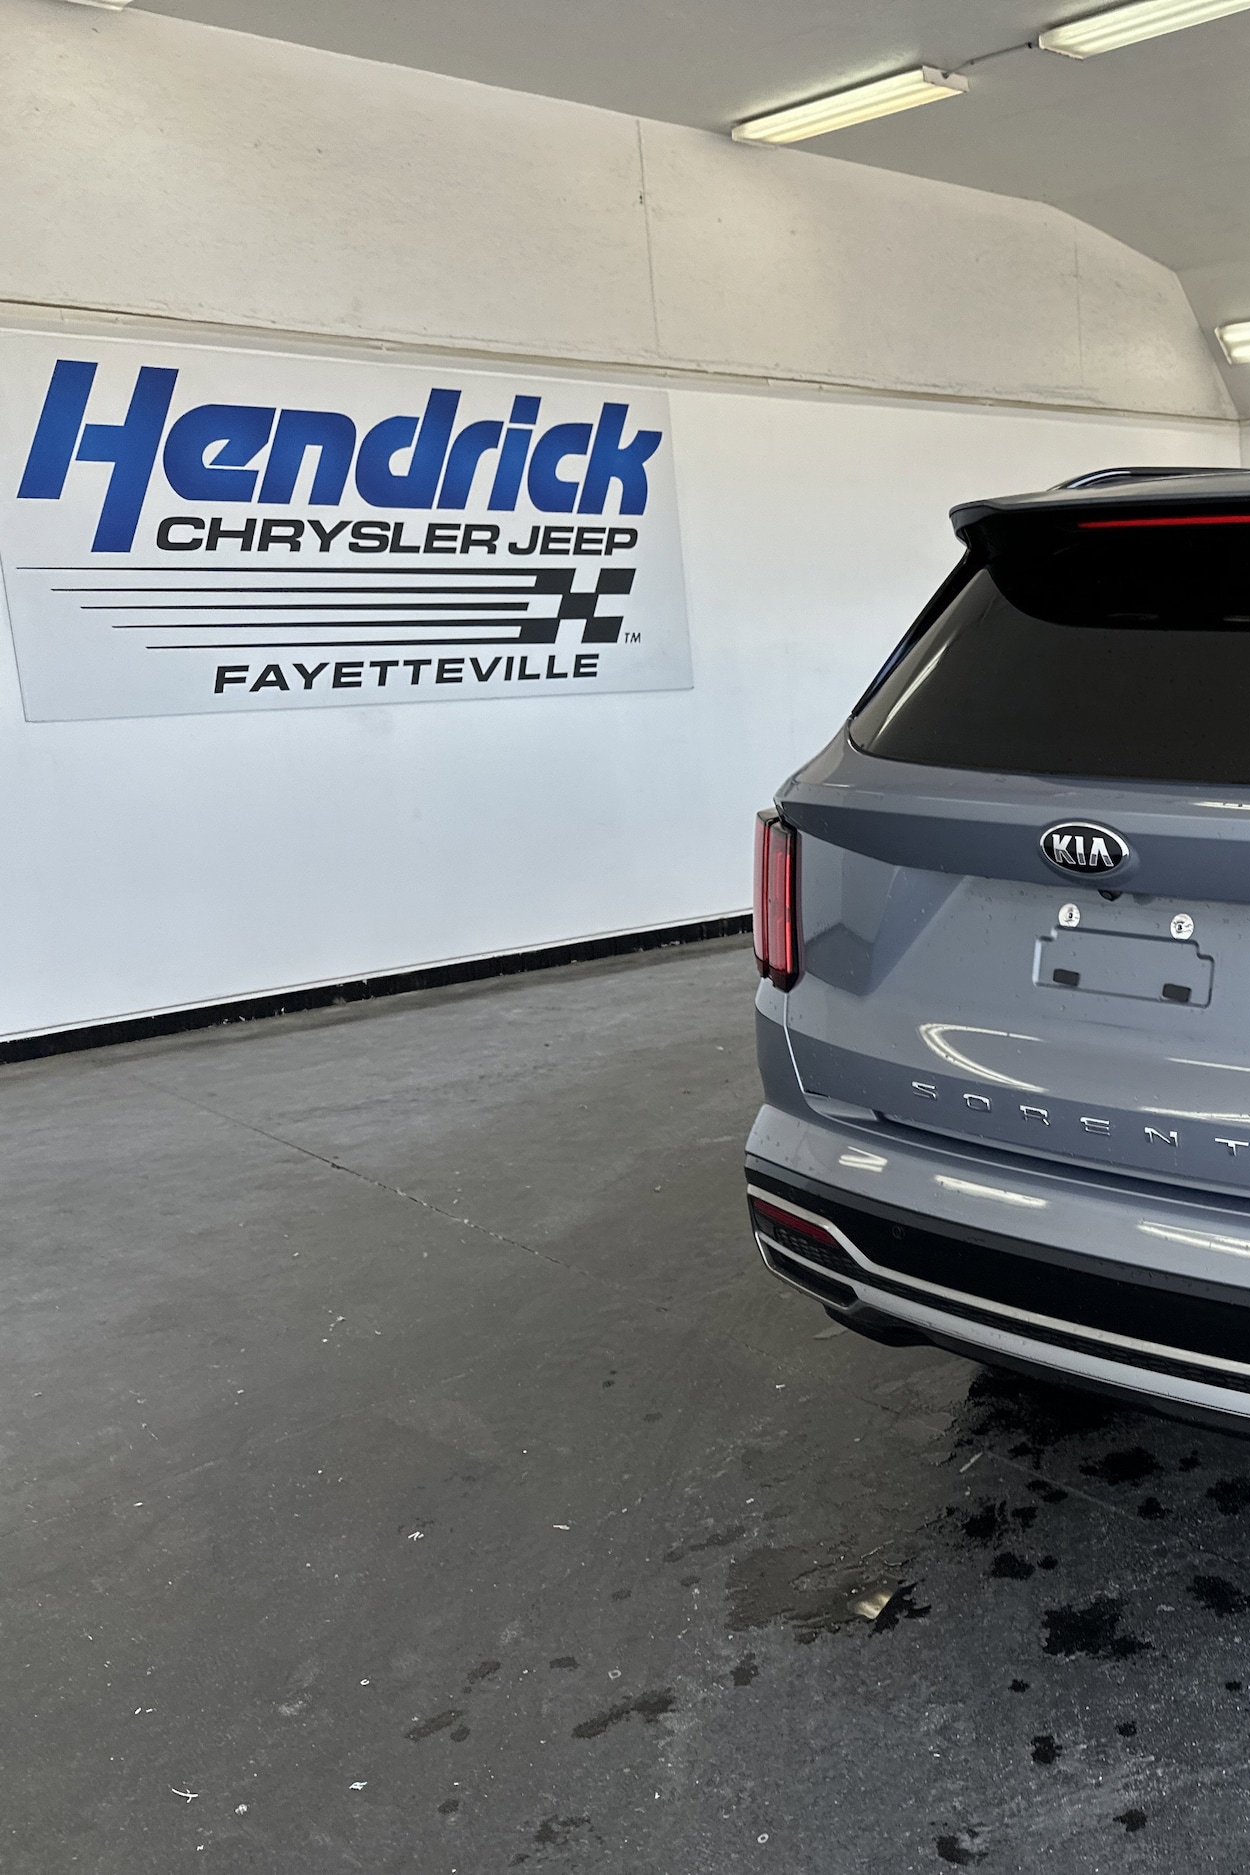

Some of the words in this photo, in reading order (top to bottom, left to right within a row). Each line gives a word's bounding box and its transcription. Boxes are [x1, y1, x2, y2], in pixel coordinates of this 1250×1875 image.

[17, 359, 662, 553] Hendrick
[156, 516, 501, 554] CHRYSLER
[508, 525, 639, 556] JEEP
[213, 653, 600, 694] FAYETTEVILLE
[1052, 833, 1115, 868] KIA
